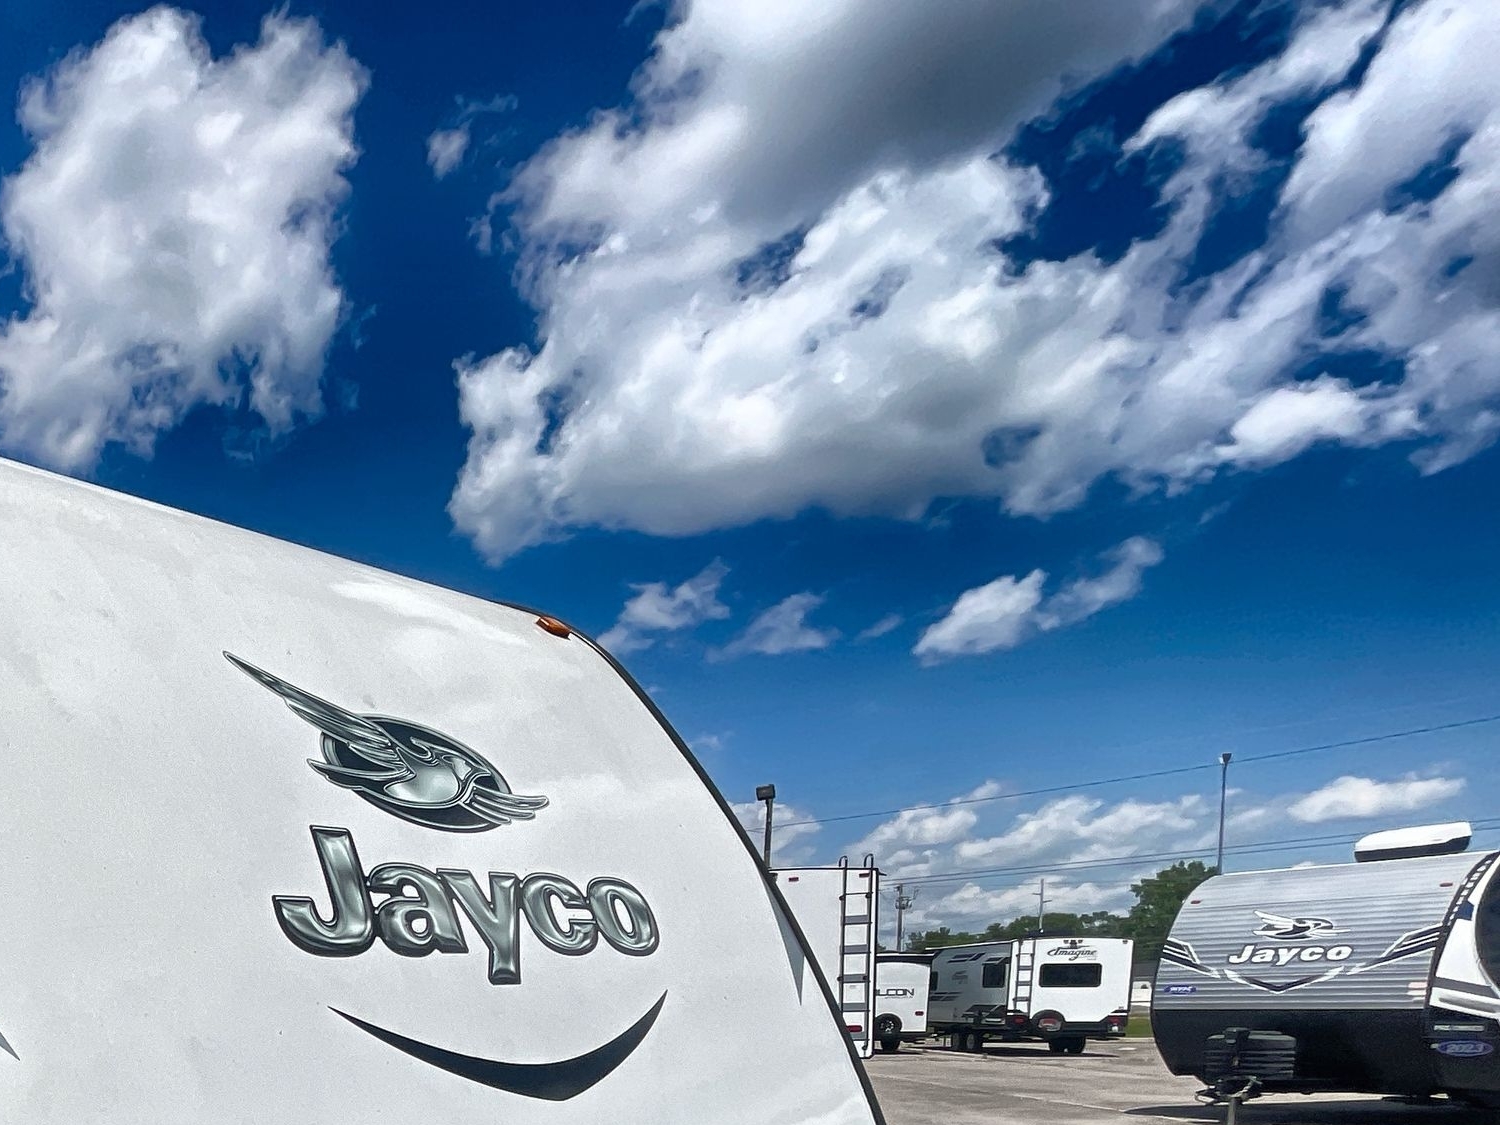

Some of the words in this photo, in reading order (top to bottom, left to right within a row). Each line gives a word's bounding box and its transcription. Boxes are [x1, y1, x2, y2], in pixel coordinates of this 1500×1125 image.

[272, 825, 660, 985] Jayco
[1047, 945, 1098, 961] Imagine
[1228, 944, 1353, 966] Jayco
